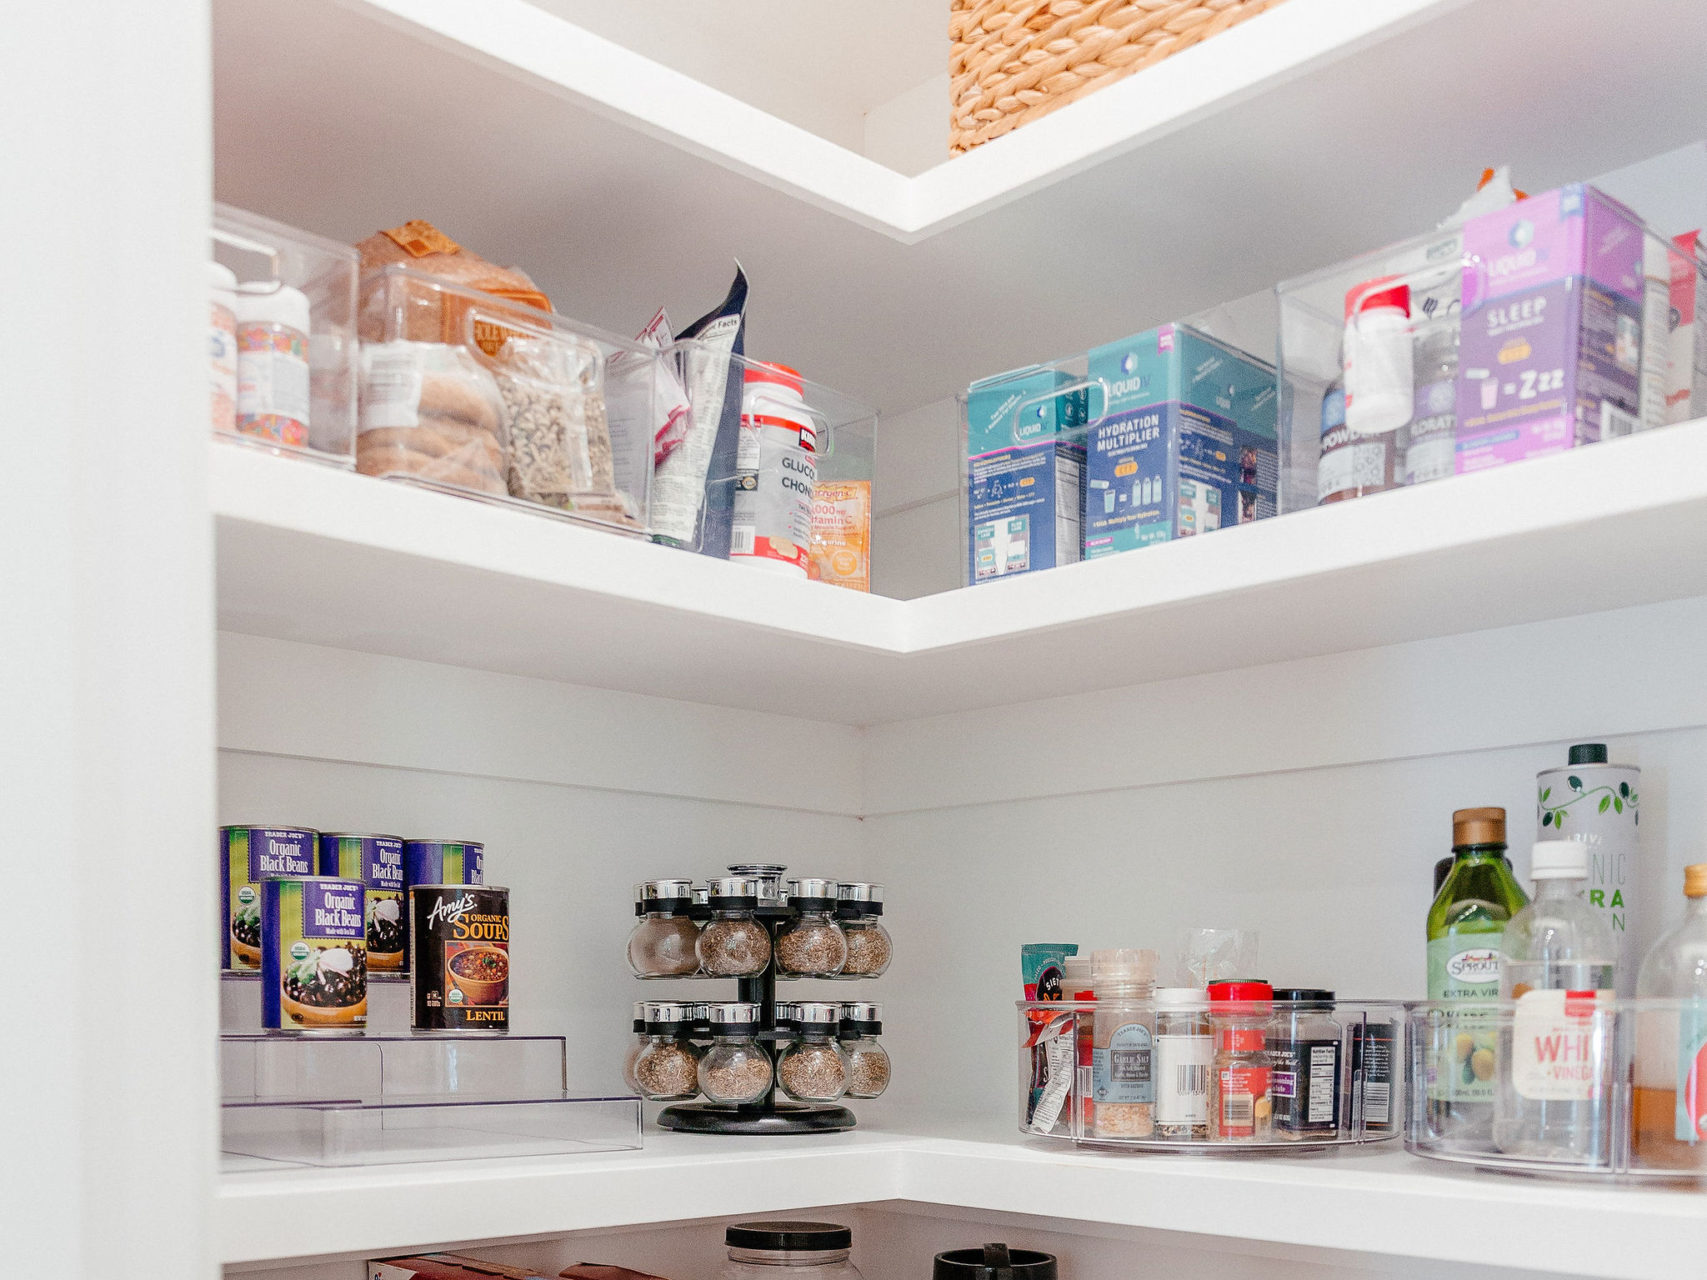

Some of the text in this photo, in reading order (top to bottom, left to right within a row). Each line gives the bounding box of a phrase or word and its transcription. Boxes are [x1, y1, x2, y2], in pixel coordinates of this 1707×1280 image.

[1487, 296, 1547, 328] SLEEP
[1108, 376, 1141, 398] LIQUID
[1098, 414, 1159, 439] HYDRATION
[1096, 427, 1160, 452] MULTIPLIER
[270, 839, 301, 857] Organic
[260, 855, 308, 873] Black Beans
[372, 863, 392, 880] Black
[325, 892, 356, 911] Organic
[315, 908, 362, 927] Black Beans
[453, 913, 510, 940] SOUPS
[471, 914, 502, 923] ORGANIC
[1443, 988, 1478, 998] EXTRA
[465, 1009, 505, 1021] LENTIL
